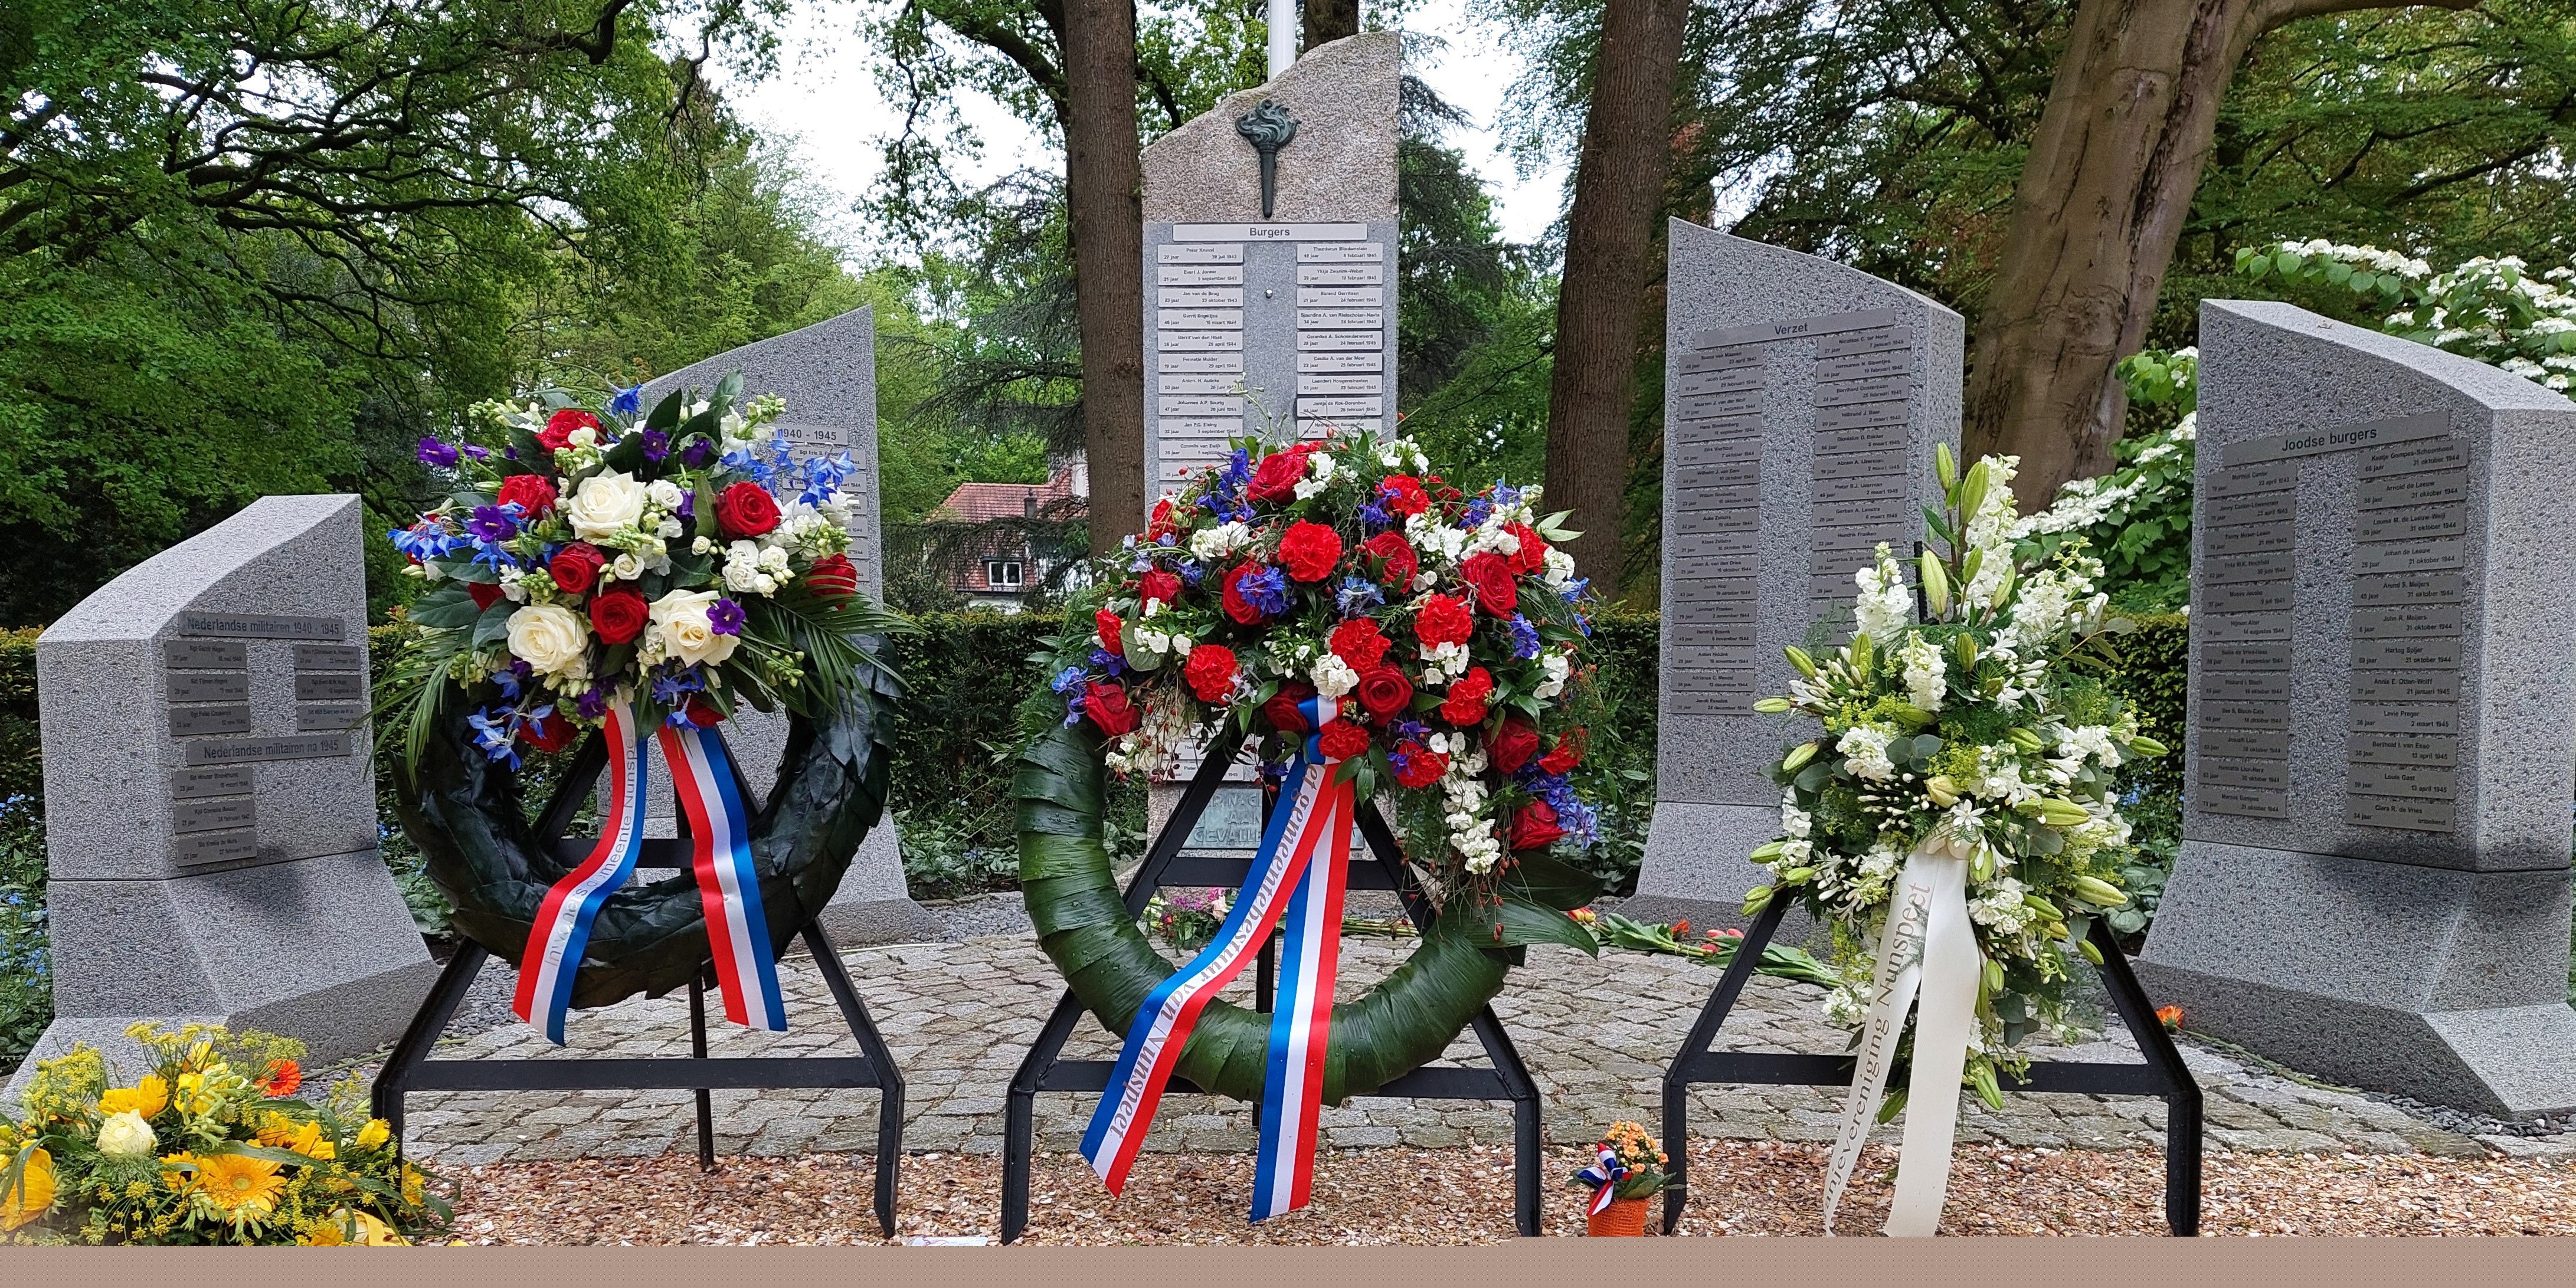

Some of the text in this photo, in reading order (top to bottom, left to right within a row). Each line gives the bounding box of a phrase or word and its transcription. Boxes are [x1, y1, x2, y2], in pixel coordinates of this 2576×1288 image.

[1250, 228, 1290, 238] Burgers
[1775, 323, 1808, 335] Verzet
[814, 430, 837, 440] 1945
[2282, 429, 2377, 451] Joodse burgers
[187, 617, 246, 632] Nederlandse
[250, 622, 290, 633] militairen
[294, 622, 312, 634] 1940
[321, 623, 339, 635] 1945
[204, 740, 339, 759] Nederlandse militairen na 1945
[587, 815, 632, 889] gemeente
[1109, 763, 1318, 1139] et gemeentebestuur van Nunspeet
[1875, 882, 1930, 1011] Nunspeet
